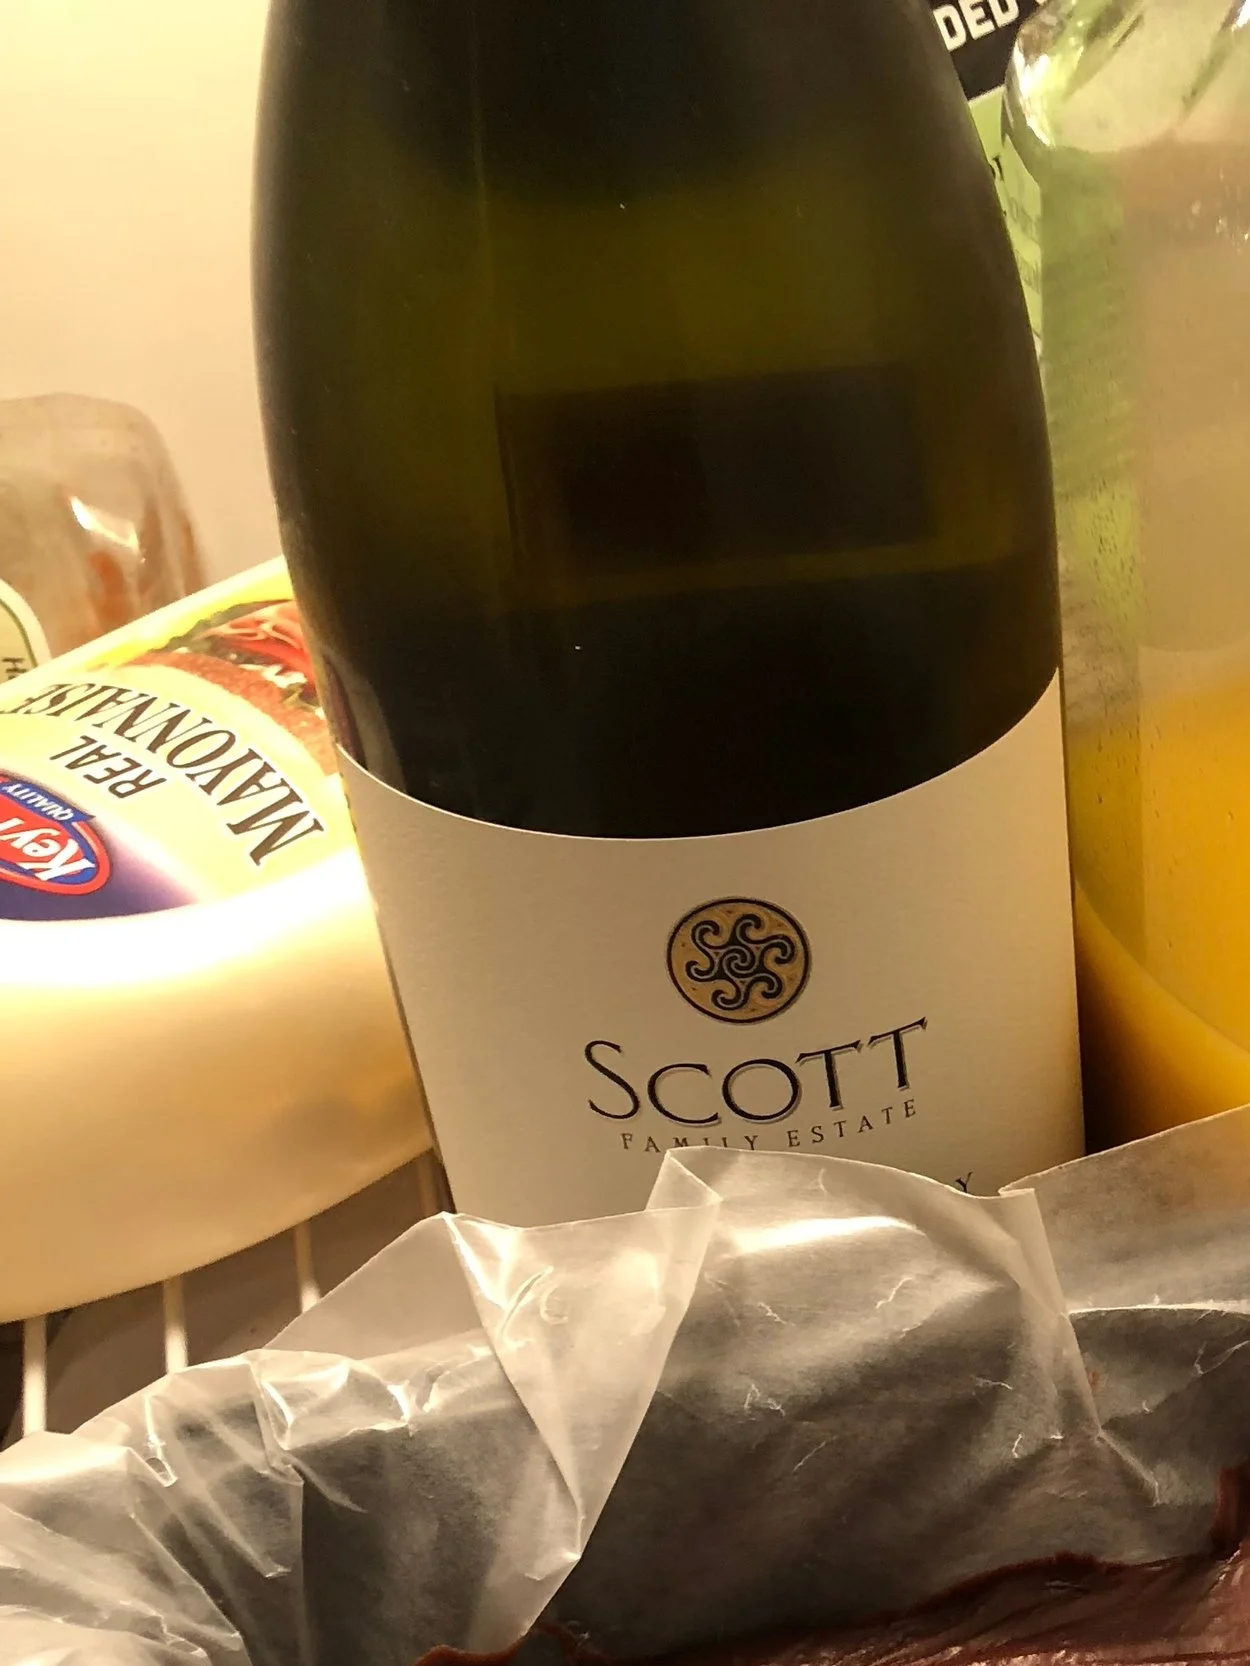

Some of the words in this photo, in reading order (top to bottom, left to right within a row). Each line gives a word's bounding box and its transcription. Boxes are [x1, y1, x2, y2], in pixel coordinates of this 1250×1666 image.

[0, 681, 325, 866] MAYONNAISE
[50, 734, 168, 799] REAL
[2, 783, 75, 821] QUALITY
[584, 1016, 928, 1127] SCOTT
[786, 1098, 917, 1149] ESTATE
